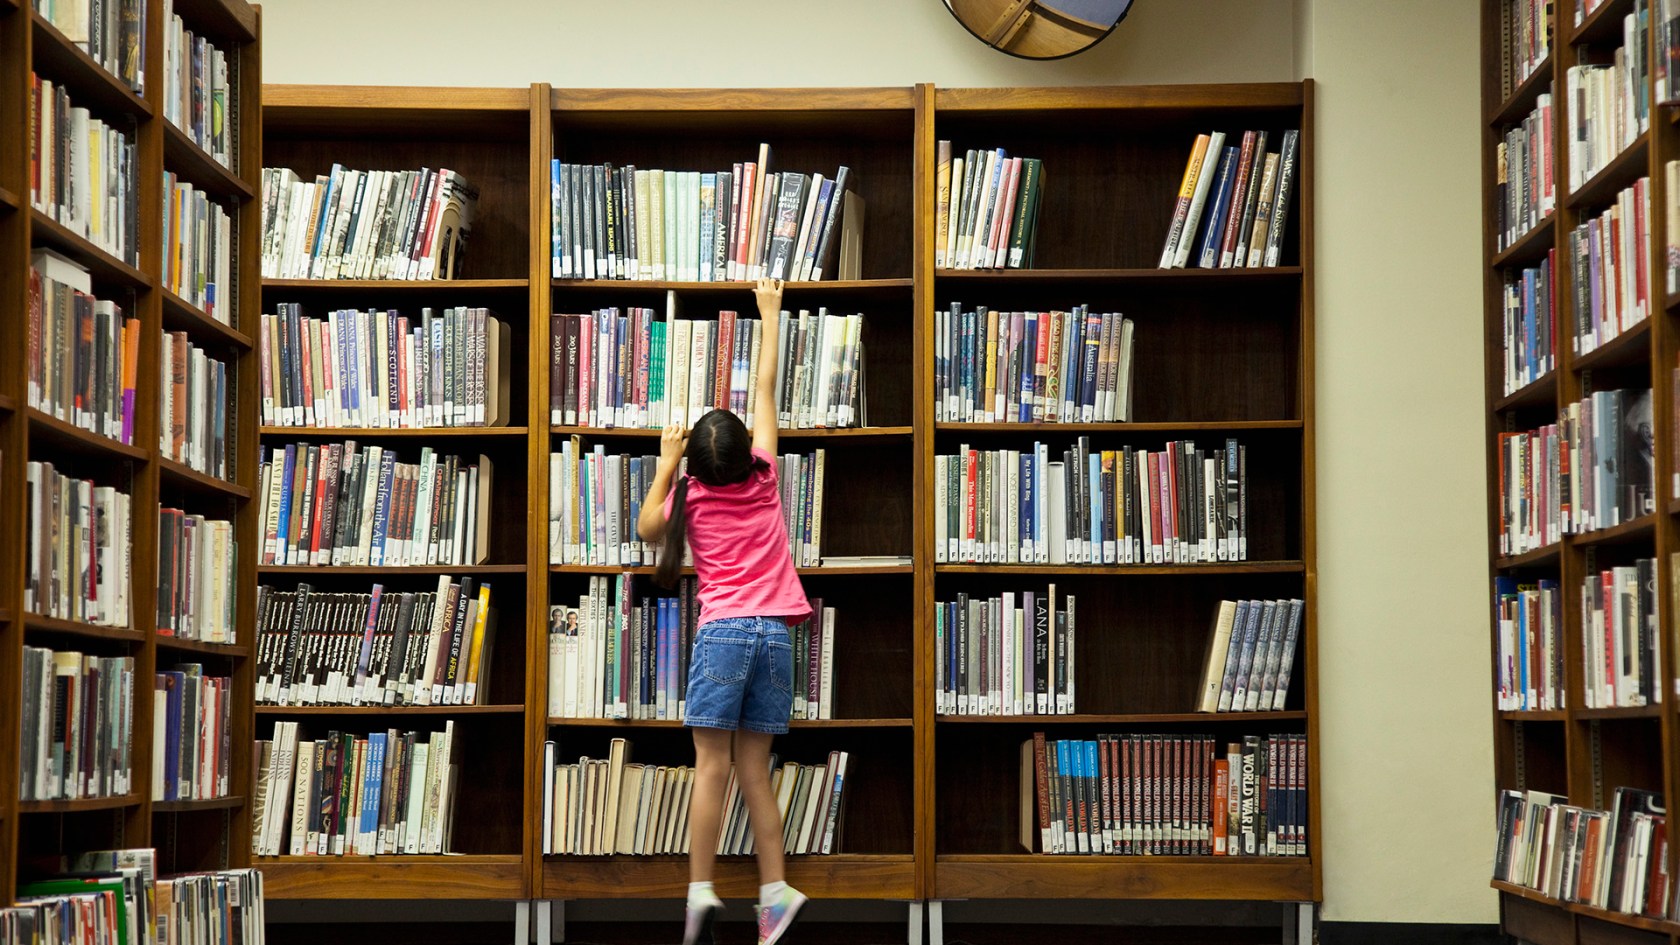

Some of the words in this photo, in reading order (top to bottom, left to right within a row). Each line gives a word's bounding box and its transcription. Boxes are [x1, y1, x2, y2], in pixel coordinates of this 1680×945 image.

[716, 222, 727, 268] AMERICA
[338, 319, 346, 340] DIANA
[347, 318, 355, 340] DIANA
[1114, 316, 1122, 336] EASTER
[476, 335, 485, 358] WARS
[554, 335, 562, 346] 200
[569, 335, 577, 347] 200
[1102, 336, 1110, 359] ISLAND
[338, 342, 346, 363] Princess
[445, 344, 453, 373] GOTHIC
[552, 346, 562, 364] YEARS
[567, 346, 576, 364] YEARS
[717, 343, 727, 372] NORTH
[1085, 345, 1097, 382] Australia
[389, 350, 398, 403] SCOTLAND
[445, 377, 453, 397] KINGS
[715, 376, 723, 409] AMERICA
[274, 457, 283, 479] USSR
[330, 462, 338, 487] RUSSIAN
[380, 455, 393, 491] Holland
[419, 465, 429, 492] CHINA
[435, 468, 443, 485] CHINA
[274, 482, 282, 496] THE
[806, 457, 814, 503] remembering
[1009, 472, 1017, 492] NOEL
[280, 485, 288, 512] RUSSIA
[376, 492, 389, 513] from
[1009, 493, 1017, 527] COWARD
[374, 513, 385, 528] the
[372, 529, 384, 545] Air
[296, 588, 306, 613] LARRY
[442, 603, 454, 632] AFRICA
[455, 620, 463, 632] THE
[1036, 597, 1047, 637] LANA
[289, 614, 300, 653] BURROWS
[452, 633, 461, 647] LIFE
[451, 648, 458, 656] OF
[810, 634, 819, 665] WHITE
[448, 657, 458, 680] AFRICA
[809, 667, 819, 701] HOUSE
[269, 750, 278, 780] INDIANS
[276, 750, 286, 780] INDIANS
[283, 750, 293, 780] INDIANS
[300, 757, 308, 774] 500
[1037, 749, 1045, 760] The
[1038, 762, 1047, 783] Golden
[1242, 754, 1254, 797] WORLD
[253, 768, 270, 832] INDIANS
[1038, 785, 1047, 797] Age
[1102, 777, 1110, 801] WORLD
[1112, 777, 1120, 801] WORLD
[1133, 777, 1141, 801] WORLD
[1143, 777, 1151, 801] WORLD
[1153, 777, 1161, 801] WORLD
[1163, 777, 1171, 801] WORLD
[1172, 777, 1180, 801] WORLD
[1230, 785, 1238, 801] GREAT
[296, 778, 307, 832] NATIONS
[1040, 805, 1049, 827] Europe
[1102, 801, 1110, 816] WAR
[1112, 801, 1120, 816] WAR
[1133, 801, 1141, 816] WAR
[1143, 801, 1151, 816] WAR
[1153, 801, 1161, 816] WAR
[1163, 801, 1171, 816] WAR
[1172, 801, 1180, 816] WAR
[1230, 802, 1238, 813] WAR
[1242, 798, 1254, 824] WAR
